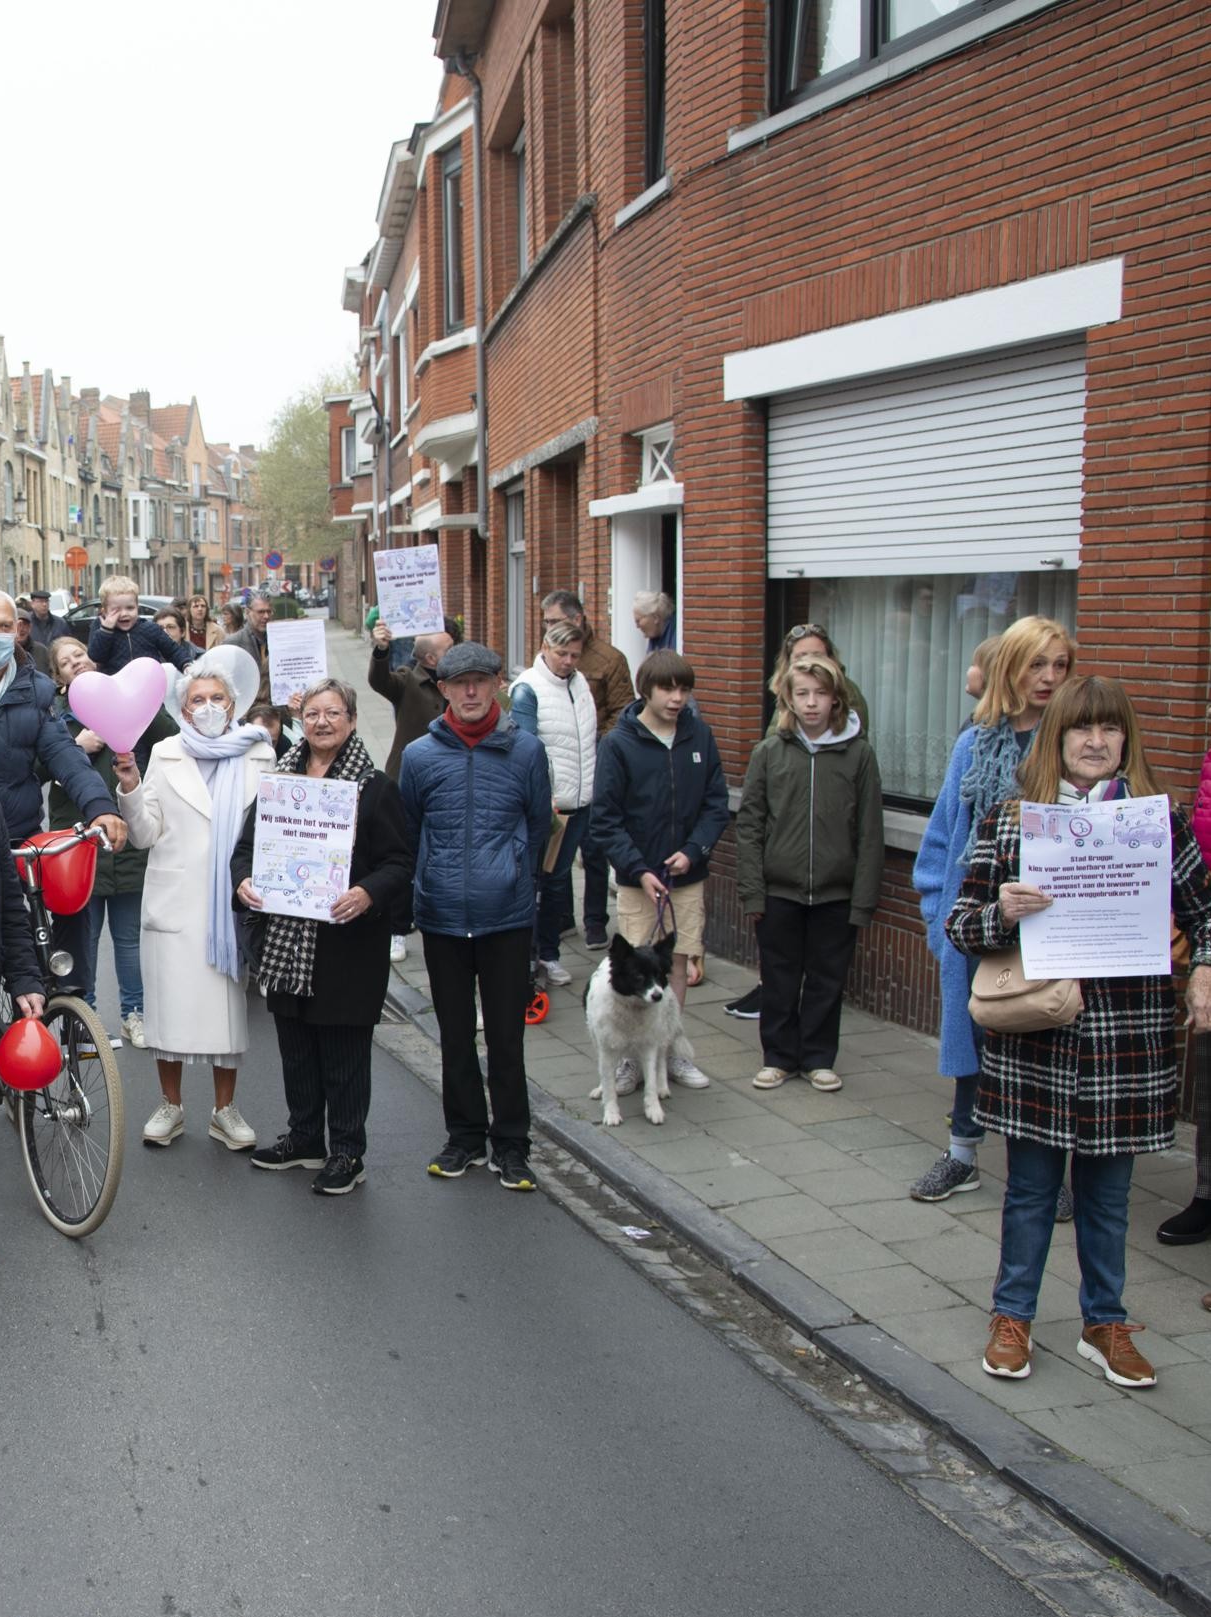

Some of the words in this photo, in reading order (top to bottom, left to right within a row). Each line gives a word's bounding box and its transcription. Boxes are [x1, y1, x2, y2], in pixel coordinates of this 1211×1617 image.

[261, 813, 272, 823] Wij
[304, 818, 316, 827] het
[318, 821, 350, 830] verkeer
[283, 829, 297, 838] niet
[1052, 872, 1104, 882] gemotoriseerd
[1078, 890, 1131, 898] weggebruikers
